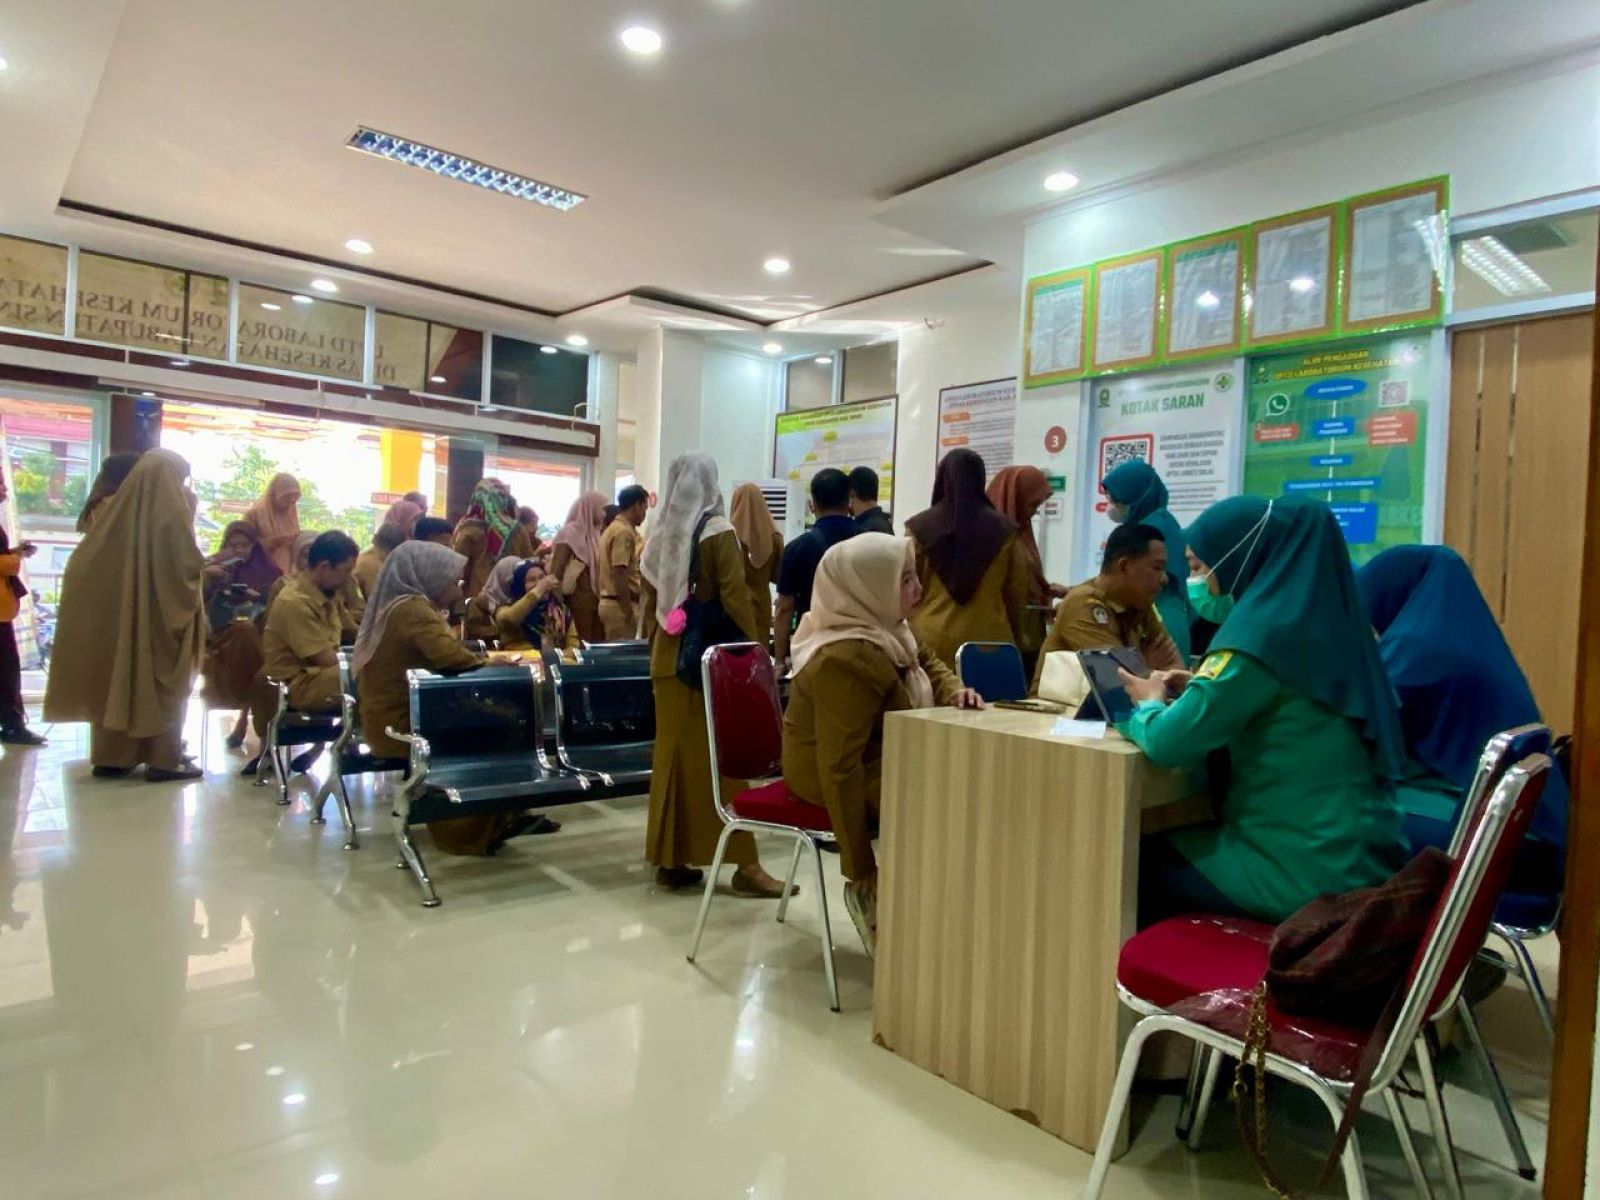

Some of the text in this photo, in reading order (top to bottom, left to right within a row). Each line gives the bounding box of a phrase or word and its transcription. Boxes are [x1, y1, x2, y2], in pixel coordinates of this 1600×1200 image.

[1120, 393, 1205, 416] KOTAK SARAN
[1051, 434, 1059, 448] 3
